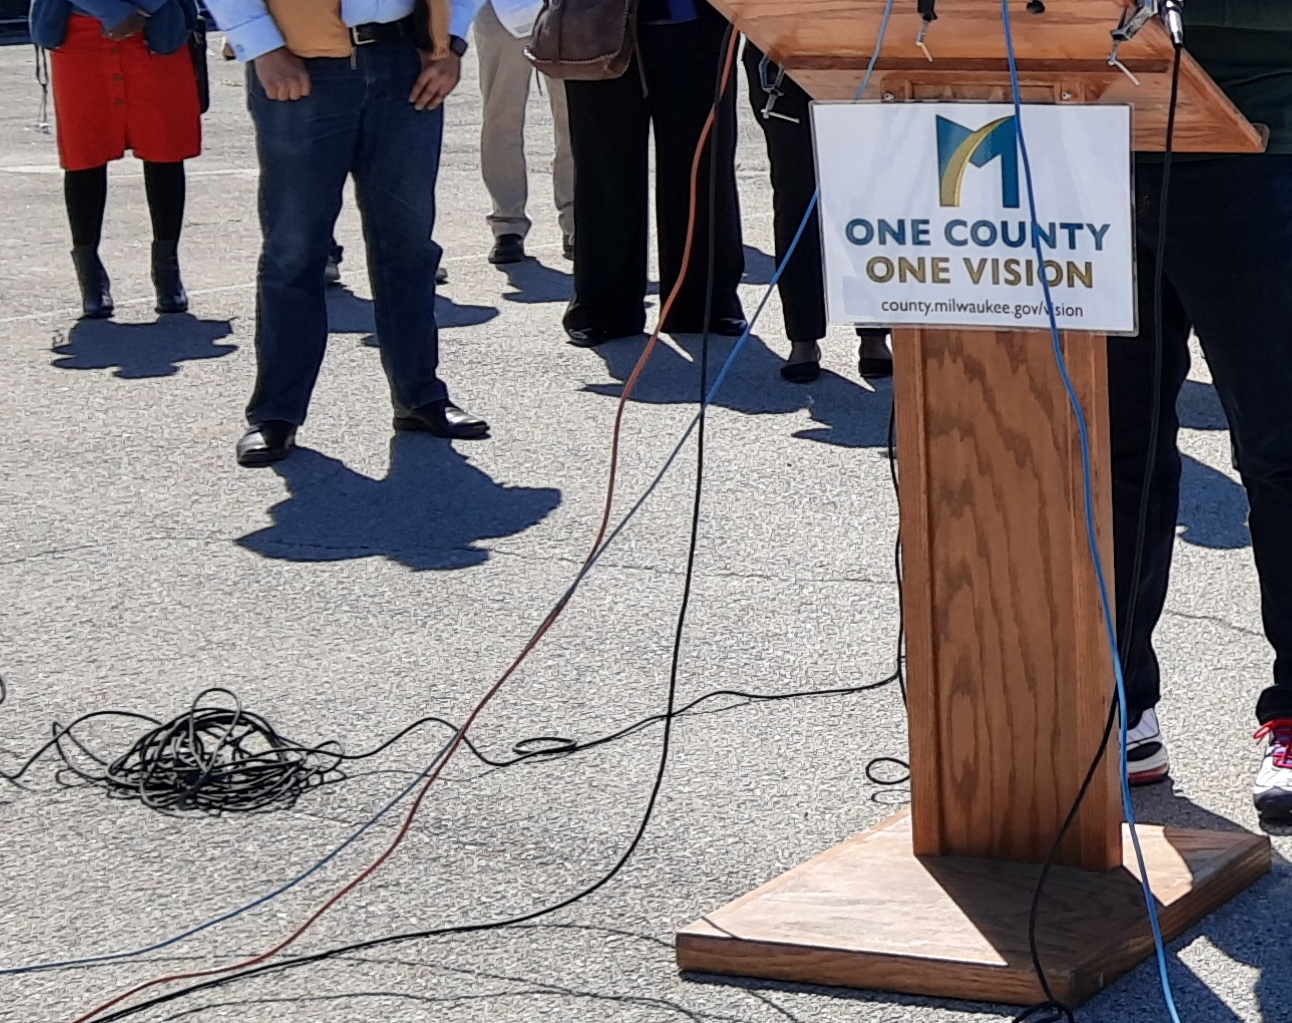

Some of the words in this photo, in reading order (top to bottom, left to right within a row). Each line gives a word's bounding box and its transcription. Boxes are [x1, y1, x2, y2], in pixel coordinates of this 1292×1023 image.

[845, 218, 931, 247] ONE
[944, 219, 1111, 251] COUNTY
[866, 255, 951, 285] ONE
[962, 257, 1094, 289] VISION
[881, 298, 1084, 319] county.milwaukee.gov/vsion
